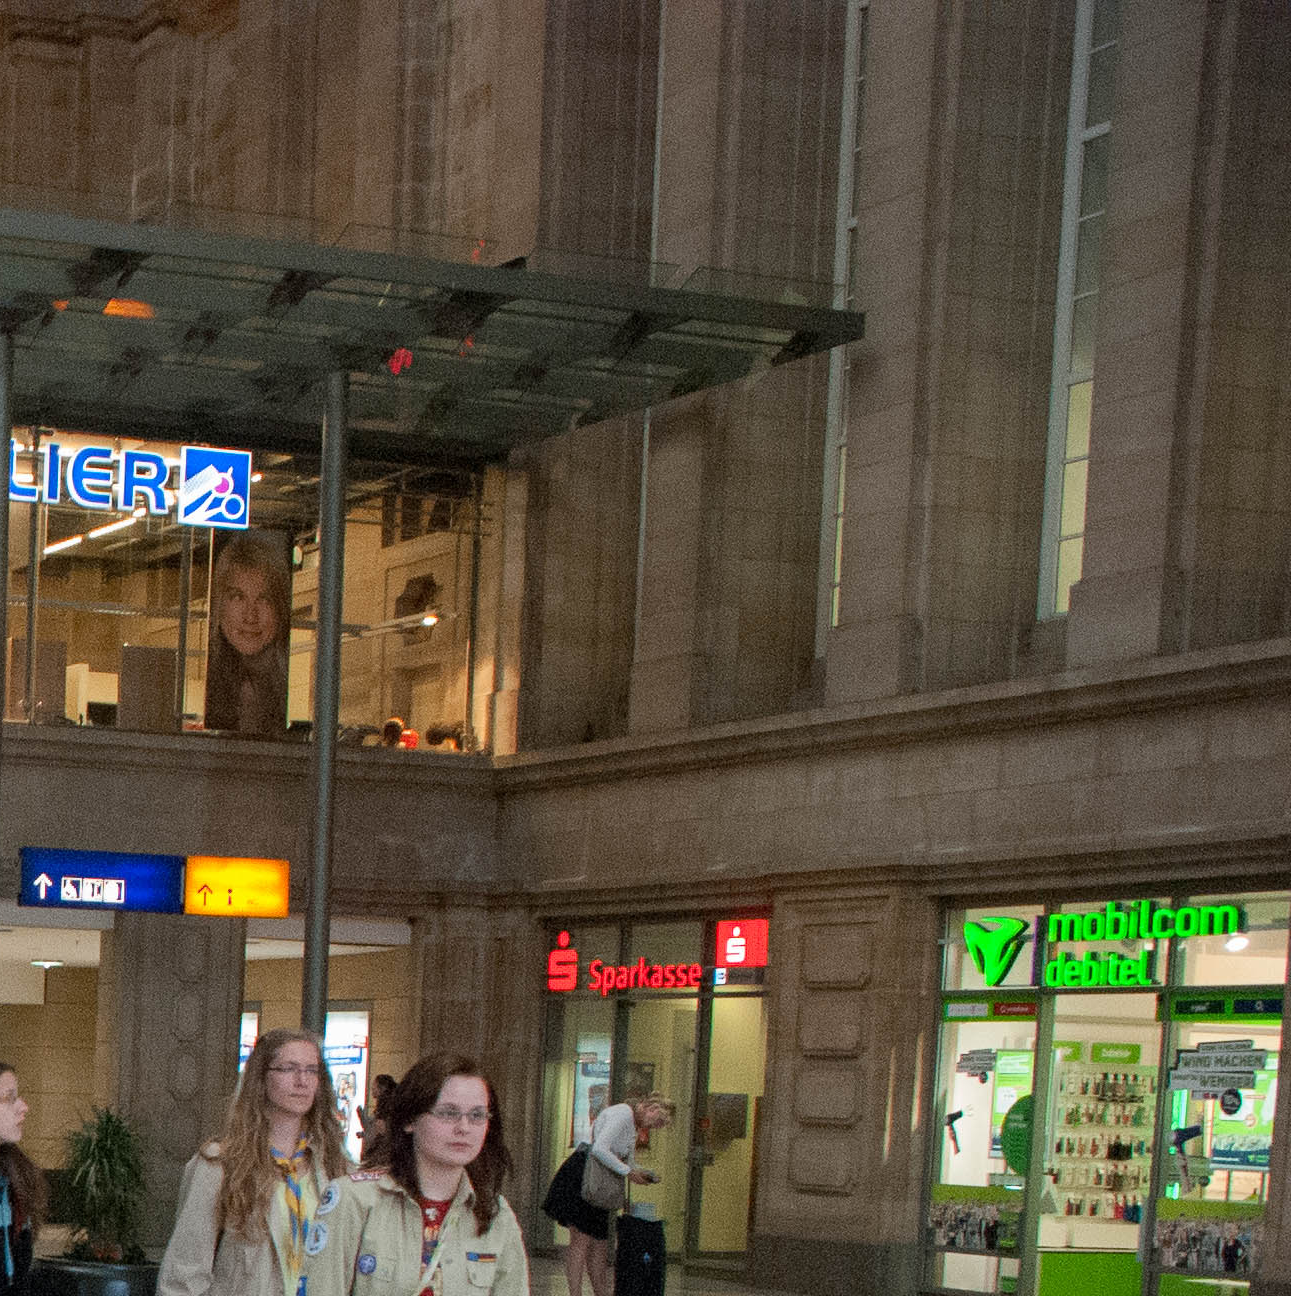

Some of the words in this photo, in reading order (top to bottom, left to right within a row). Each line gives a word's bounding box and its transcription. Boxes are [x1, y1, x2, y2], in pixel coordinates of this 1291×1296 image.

[1048, 900, 1239, 942] mobilcom
[588, 957, 702, 997] Sparkasse
[1045, 951, 1153, 987] debitel
[1212, 1054, 1263, 1068] MACHEN
